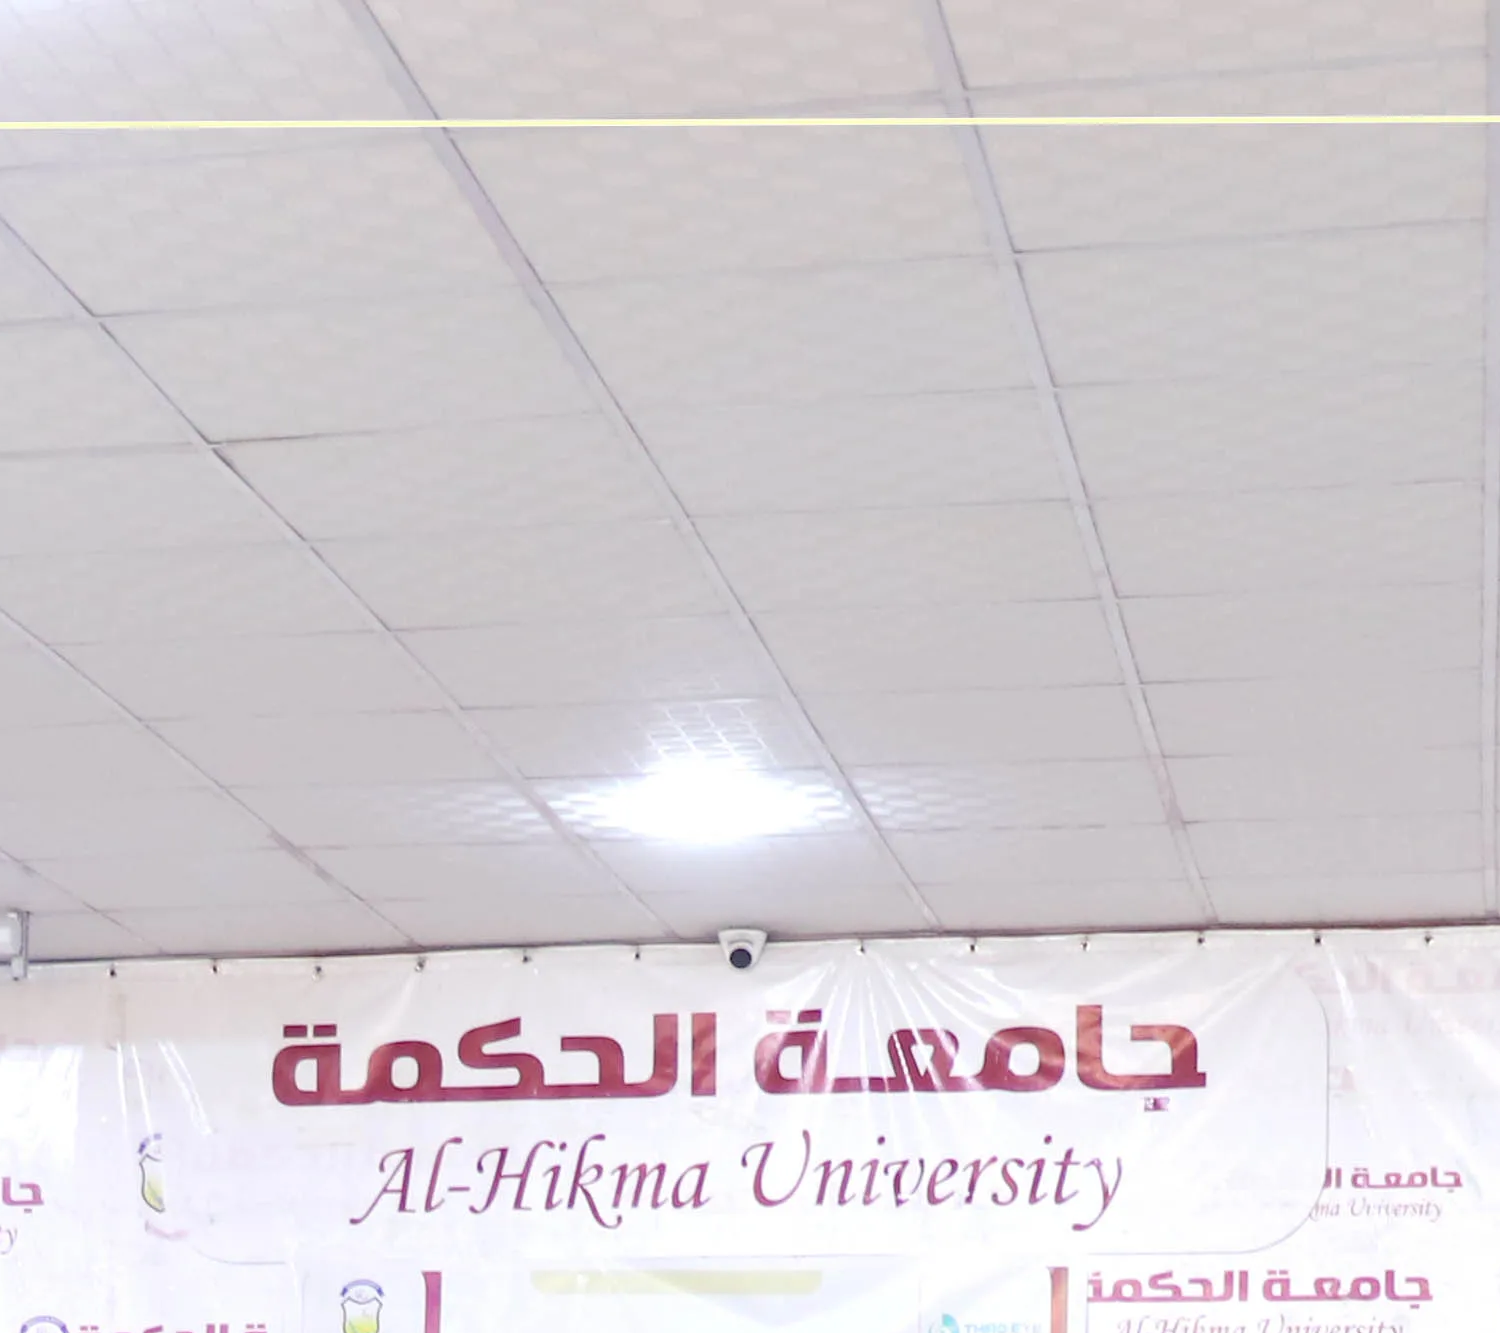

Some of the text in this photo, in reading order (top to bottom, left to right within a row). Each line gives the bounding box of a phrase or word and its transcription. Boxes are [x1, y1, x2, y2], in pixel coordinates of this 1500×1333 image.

[272, 1004, 1207, 1113] جامعة الحكمة
[349, 1130, 1123, 1232] Al-Hikma University
[1350, 1165, 1463, 1193] جامعة
[1263, 1270, 1433, 1310] جامعة
